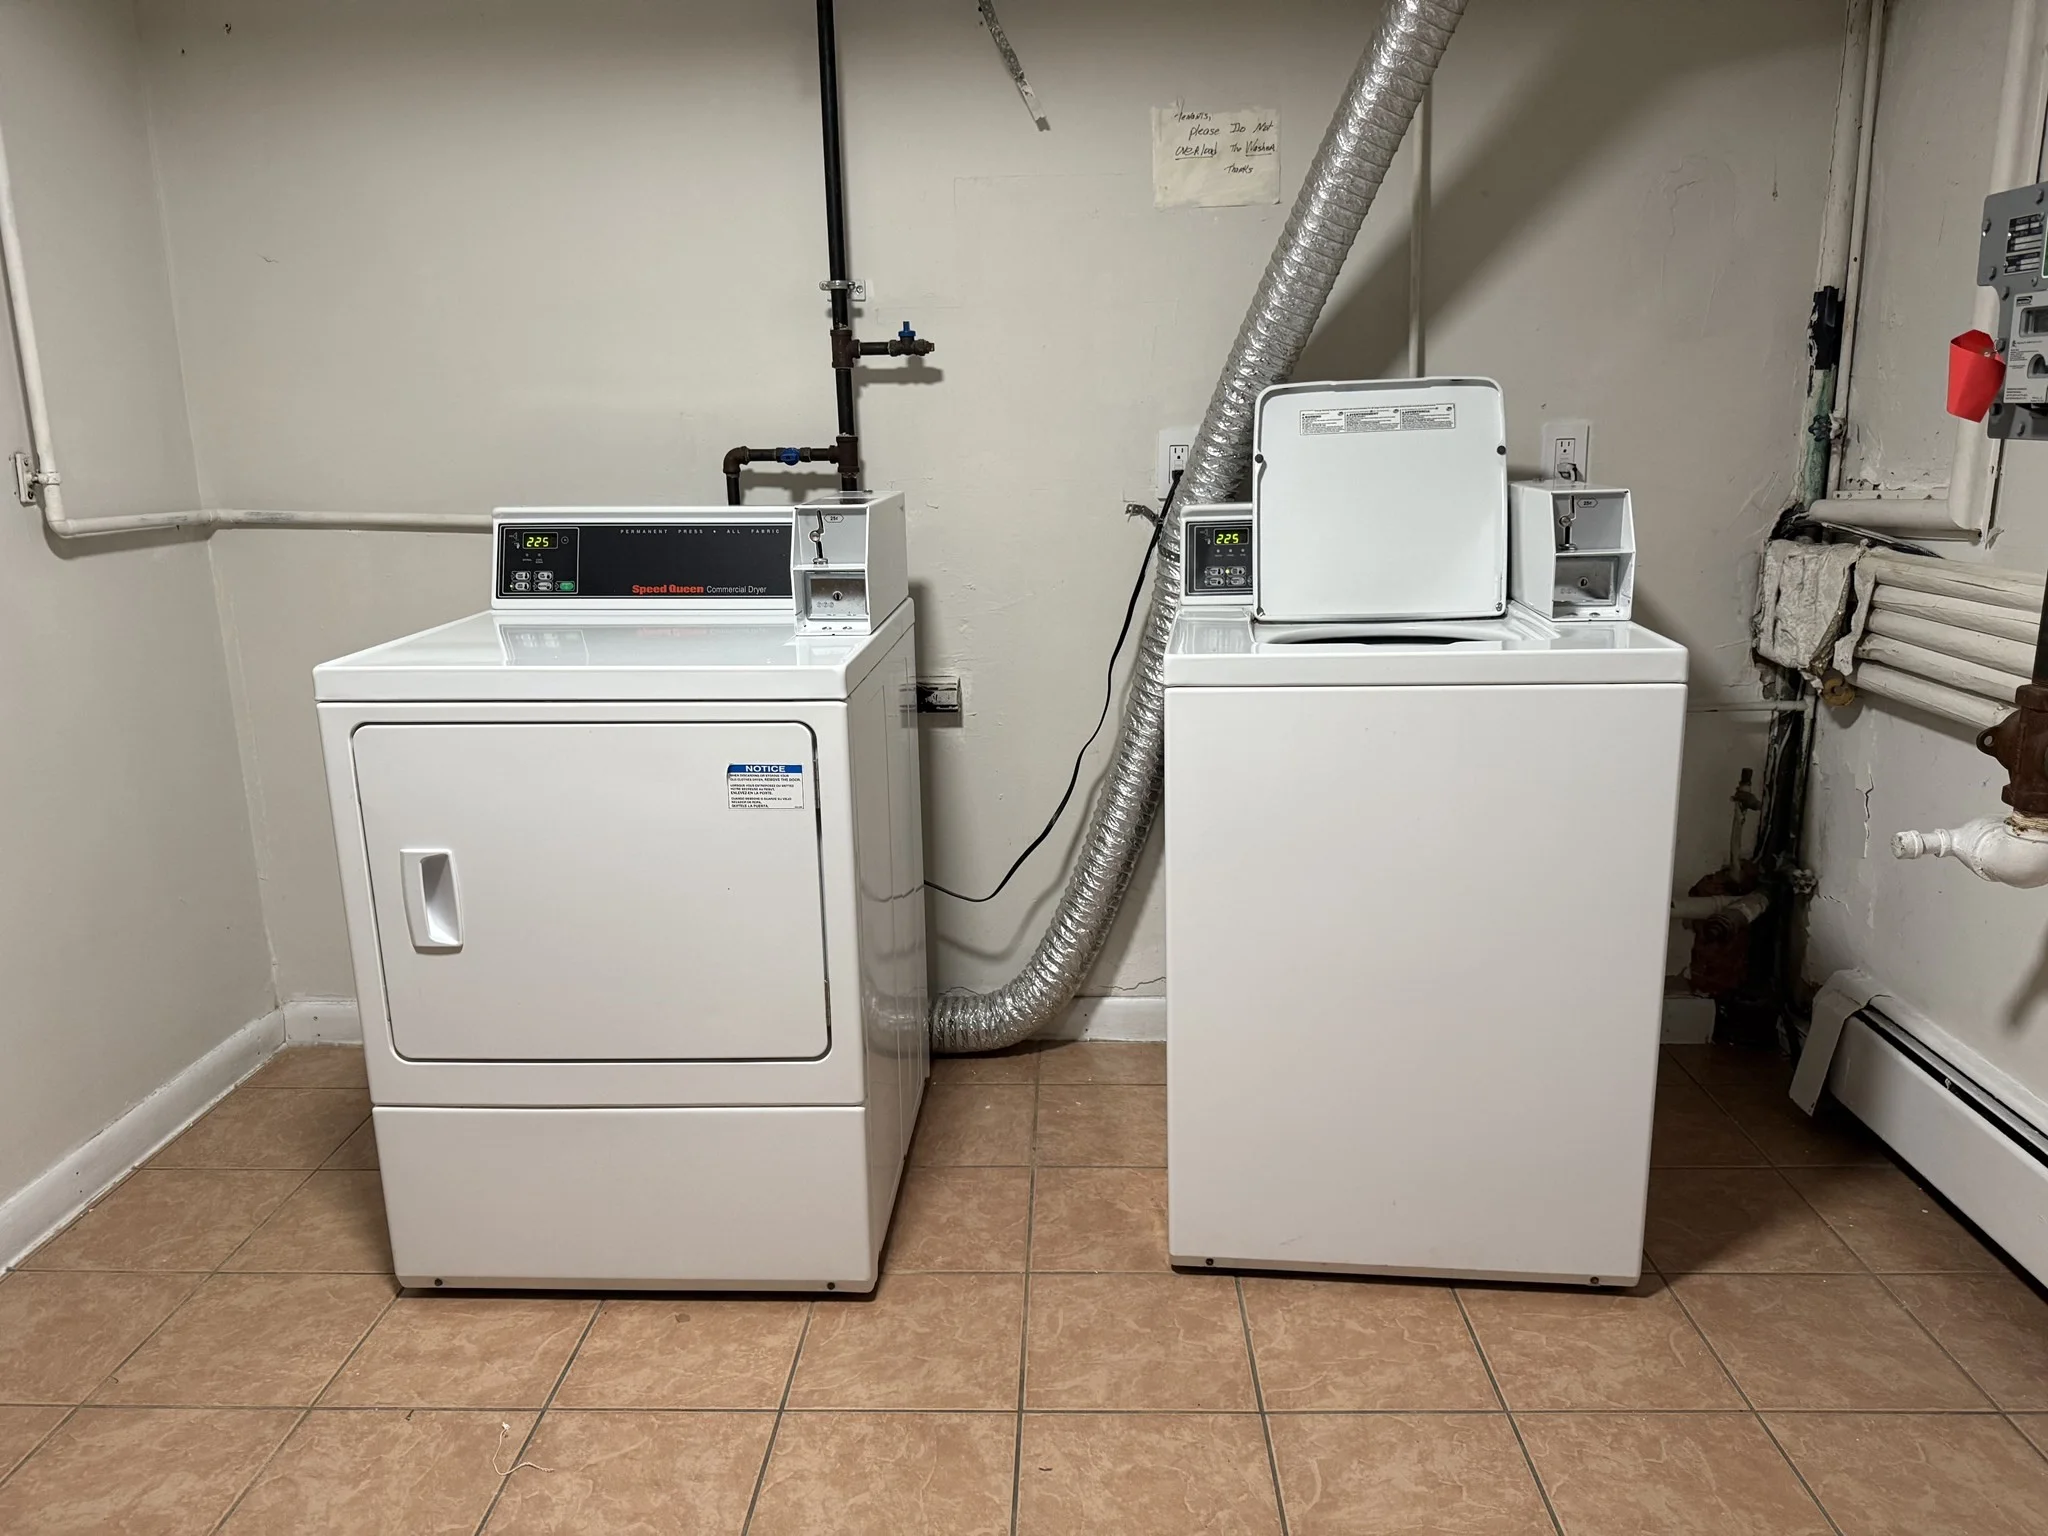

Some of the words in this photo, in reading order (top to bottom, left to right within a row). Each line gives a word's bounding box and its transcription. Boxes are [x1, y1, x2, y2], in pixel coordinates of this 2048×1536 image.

[1188, 123, 1220, 141] please
[1229, 122, 1246, 134] Do
[1252, 120, 1274, 134] Not
[526, 536, 549, 548] 225
[1216, 533, 1239, 545] 225
[632, 584, 667, 595] Speed
[668, 584, 704, 594] Queen
[706, 585, 747, 594] Commercial
[748, 585, 767, 595] Dryer
[745, 765, 786, 773] NOTICE
